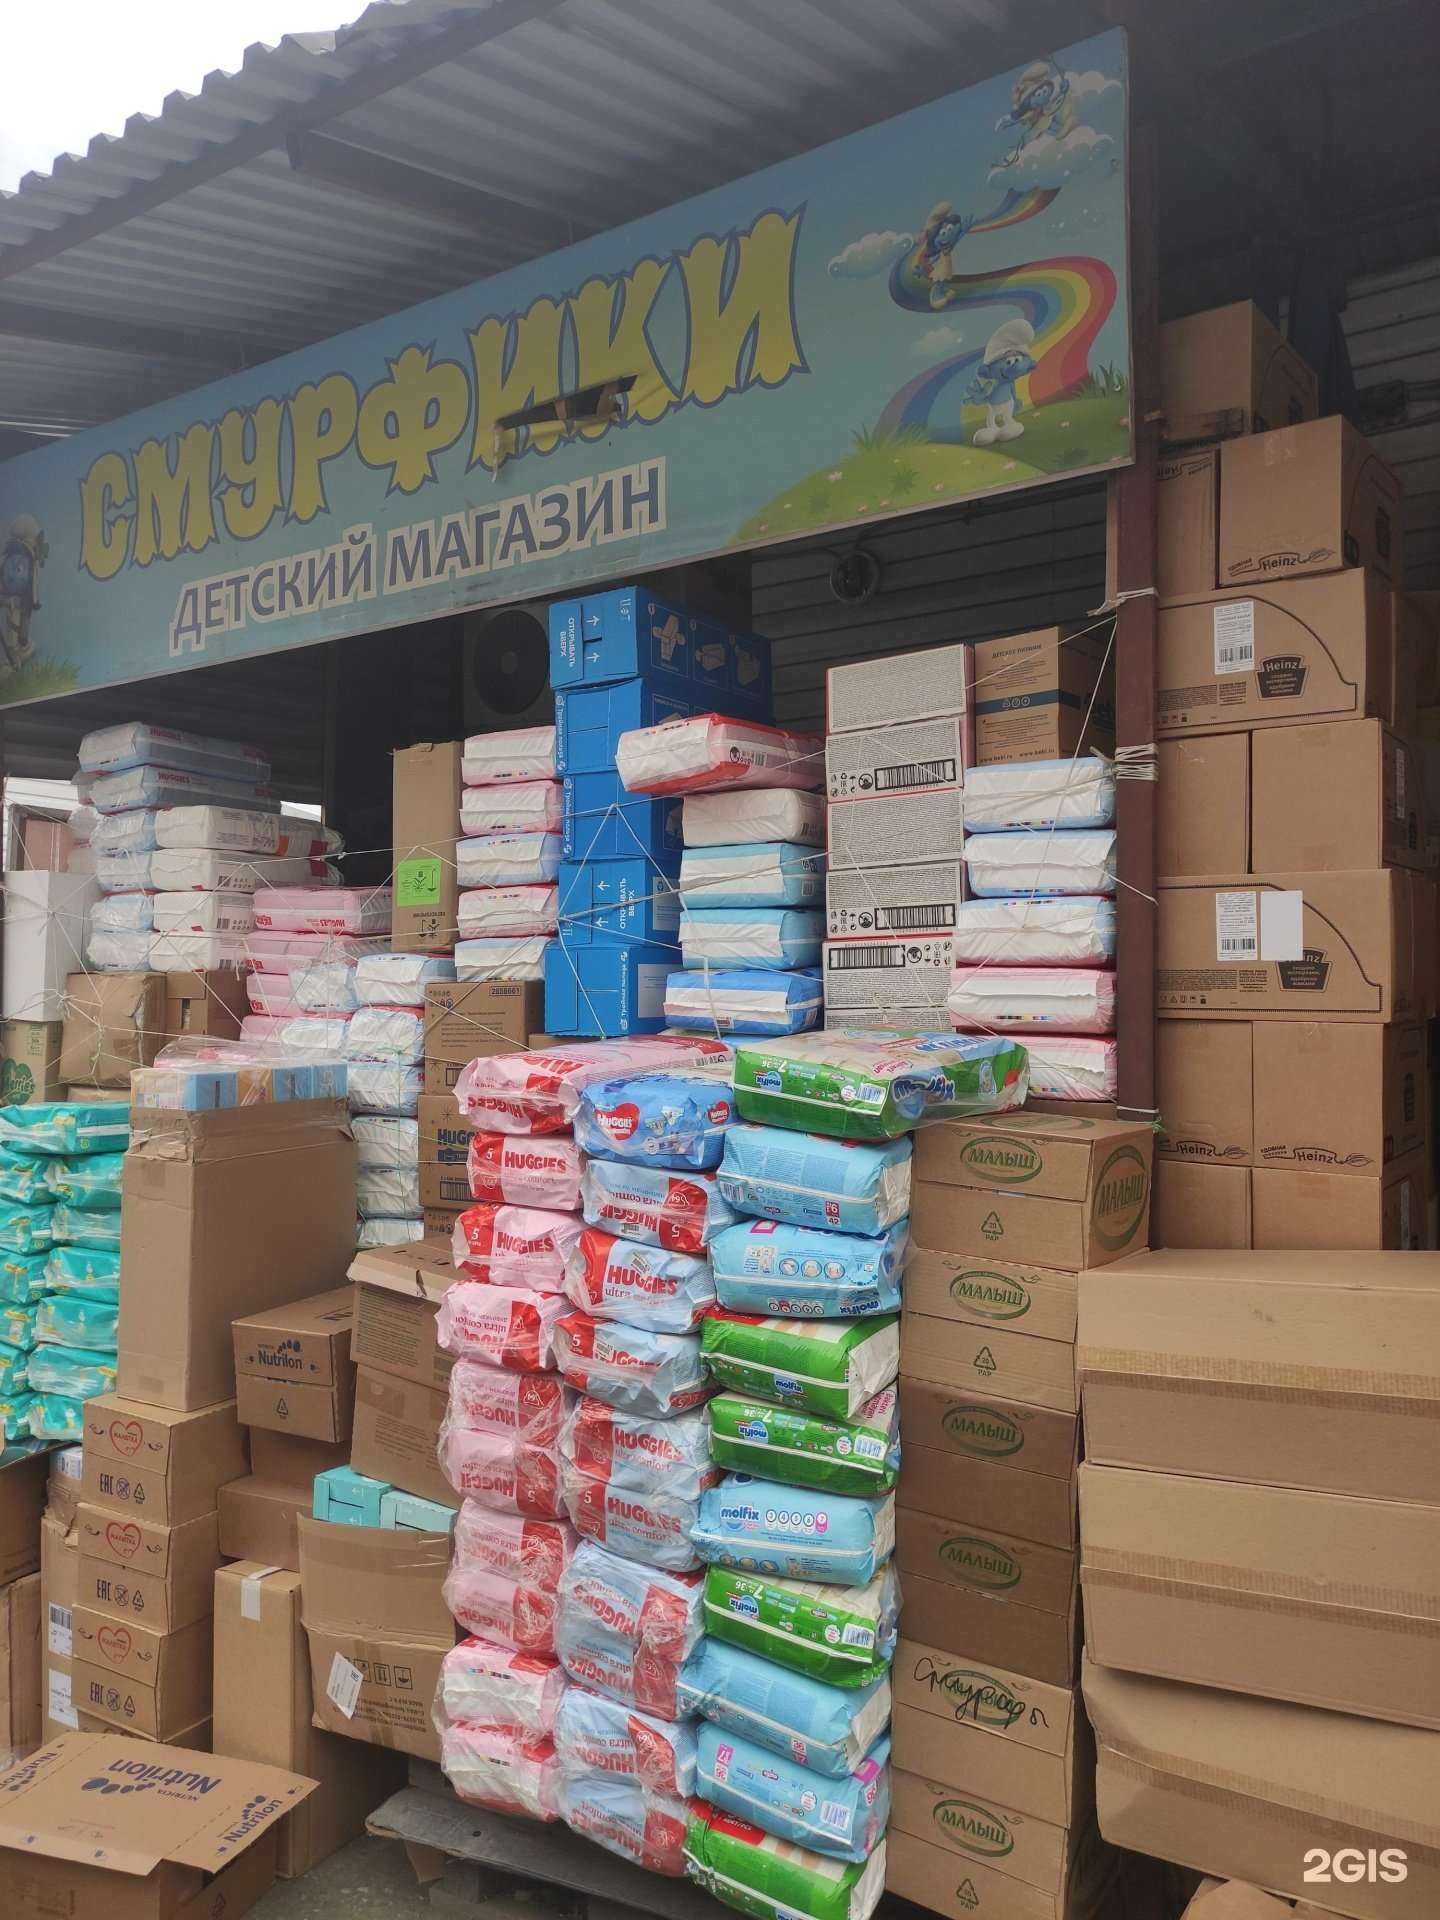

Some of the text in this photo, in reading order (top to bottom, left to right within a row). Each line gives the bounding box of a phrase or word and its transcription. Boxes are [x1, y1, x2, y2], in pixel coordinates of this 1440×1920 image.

[79, 201, 810, 579] СМУРФИКИ
[171, 465, 660, 651] ДЕТСКИЙ МАГАЗИН
[1262, 556, 1297, 571] Heinz
[1265, 660, 1299, 673] Heinz
[757, 1076, 782, 1089] molfix
[486, 1147, 494, 1160] 5
[968, 1147, 1037, 1170] МАЛЫШ
[1180, 1143, 1214, 1157] Heinz
[1296, 1150, 1334, 1164] Heinz
[504, 1151, 567, 1174] HUGGIES
[1098, 1174, 1147, 1218] МАЛЫШ
[471, 1227, 480, 1241] 5
[671, 1224, 680, 1239] 5
[496, 1230, 555, 1254] HUGGIES
[606, 1264, 678, 1296] HUGGIES
[958, 1282, 1024, 1307] МАЛЫШ
[572, 1333, 581, 1347] 5
[256, 1348, 304, 1370] Nutrilon
[775, 1379, 803, 1392] molfix
[738, 1425, 768, 1439] molfix
[951, 1416, 1017, 1443] МАЛЫШ
[583, 1490, 593, 1504] 5
[720, 1505, 760, 1522] molfix
[948, 1547, 1013, 1577] МАЛЫШ
[729, 1598, 758, 1614] molfix
[109, 1758, 222, 1795] Nutrilon
[157, 1788, 199, 1802] NUTRICIA
[224, 1798, 283, 1843] Nutrilon
[941, 1808, 1006, 1845] МАЛЫШ
